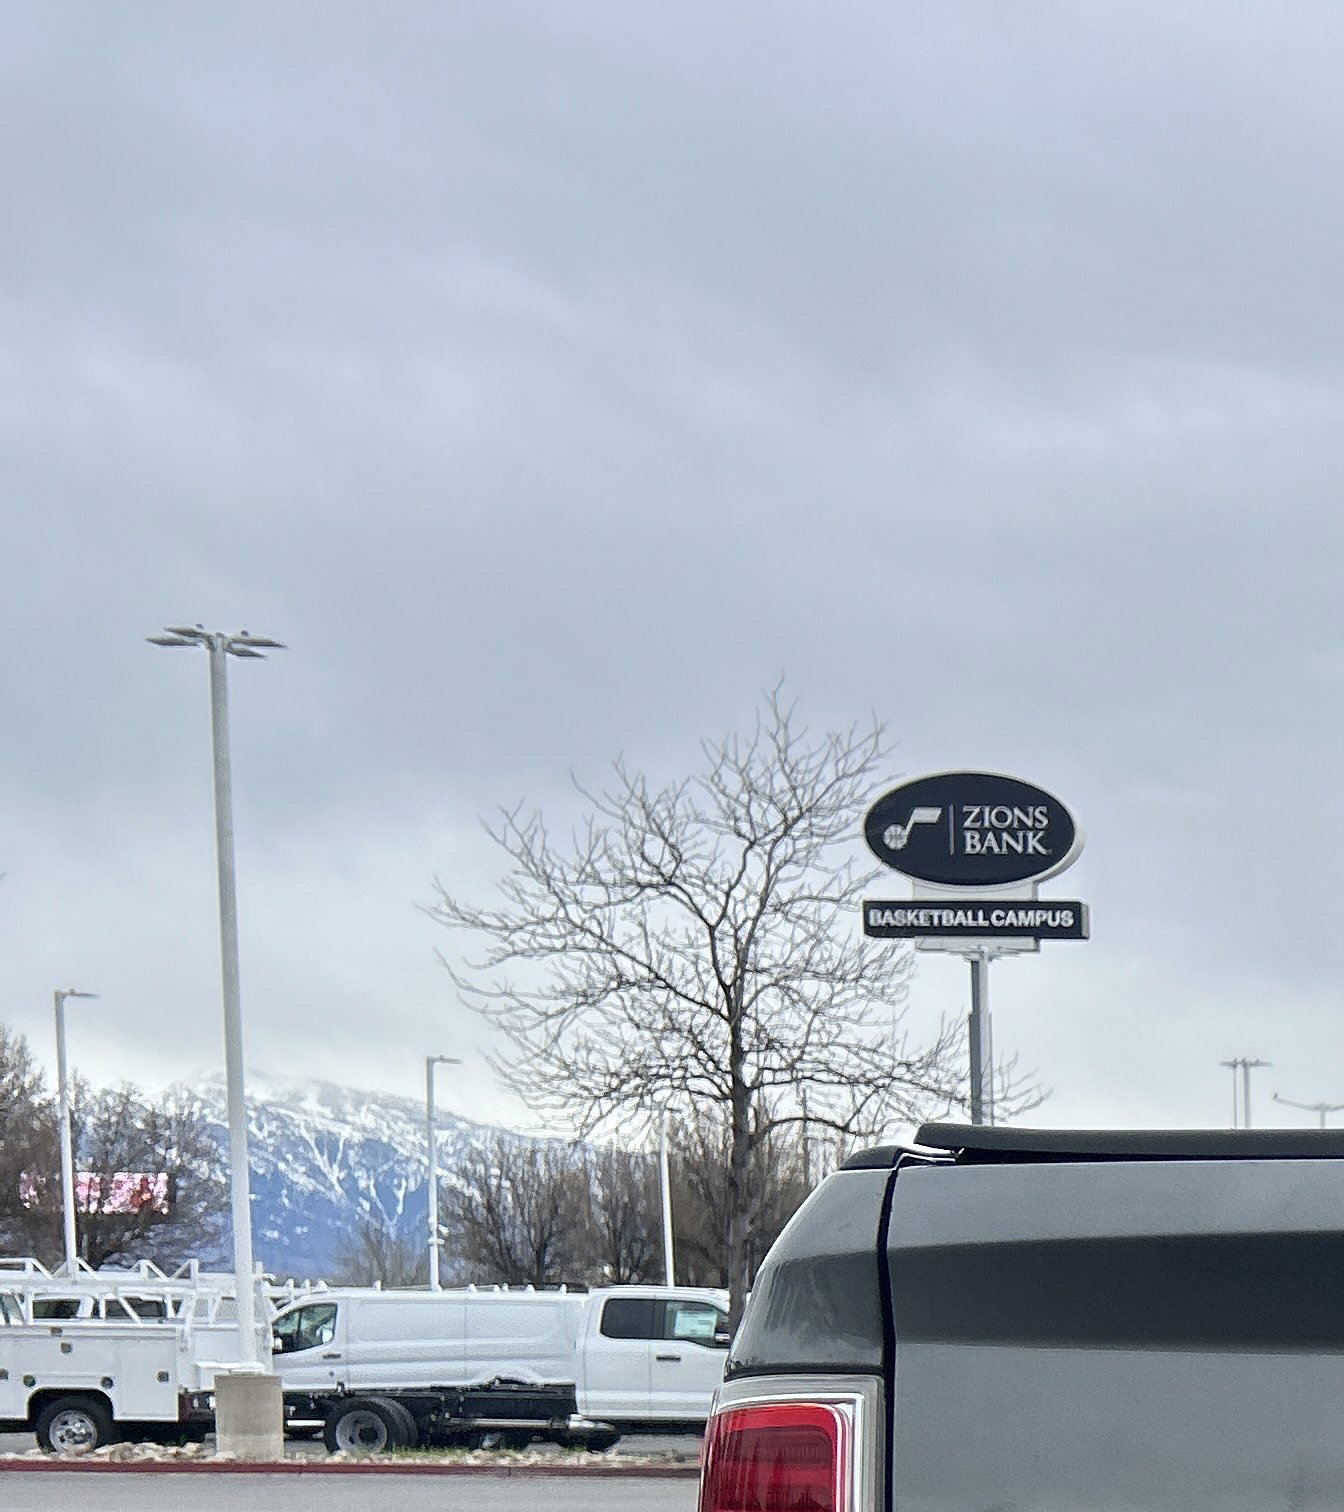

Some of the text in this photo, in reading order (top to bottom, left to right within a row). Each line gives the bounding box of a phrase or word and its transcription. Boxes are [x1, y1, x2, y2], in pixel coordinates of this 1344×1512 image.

[962, 805, 1049, 830] ZIONS
[962, 830, 1050, 855] BANK
[868, 909, 1075, 928] BASKETBALL CAMPUS
